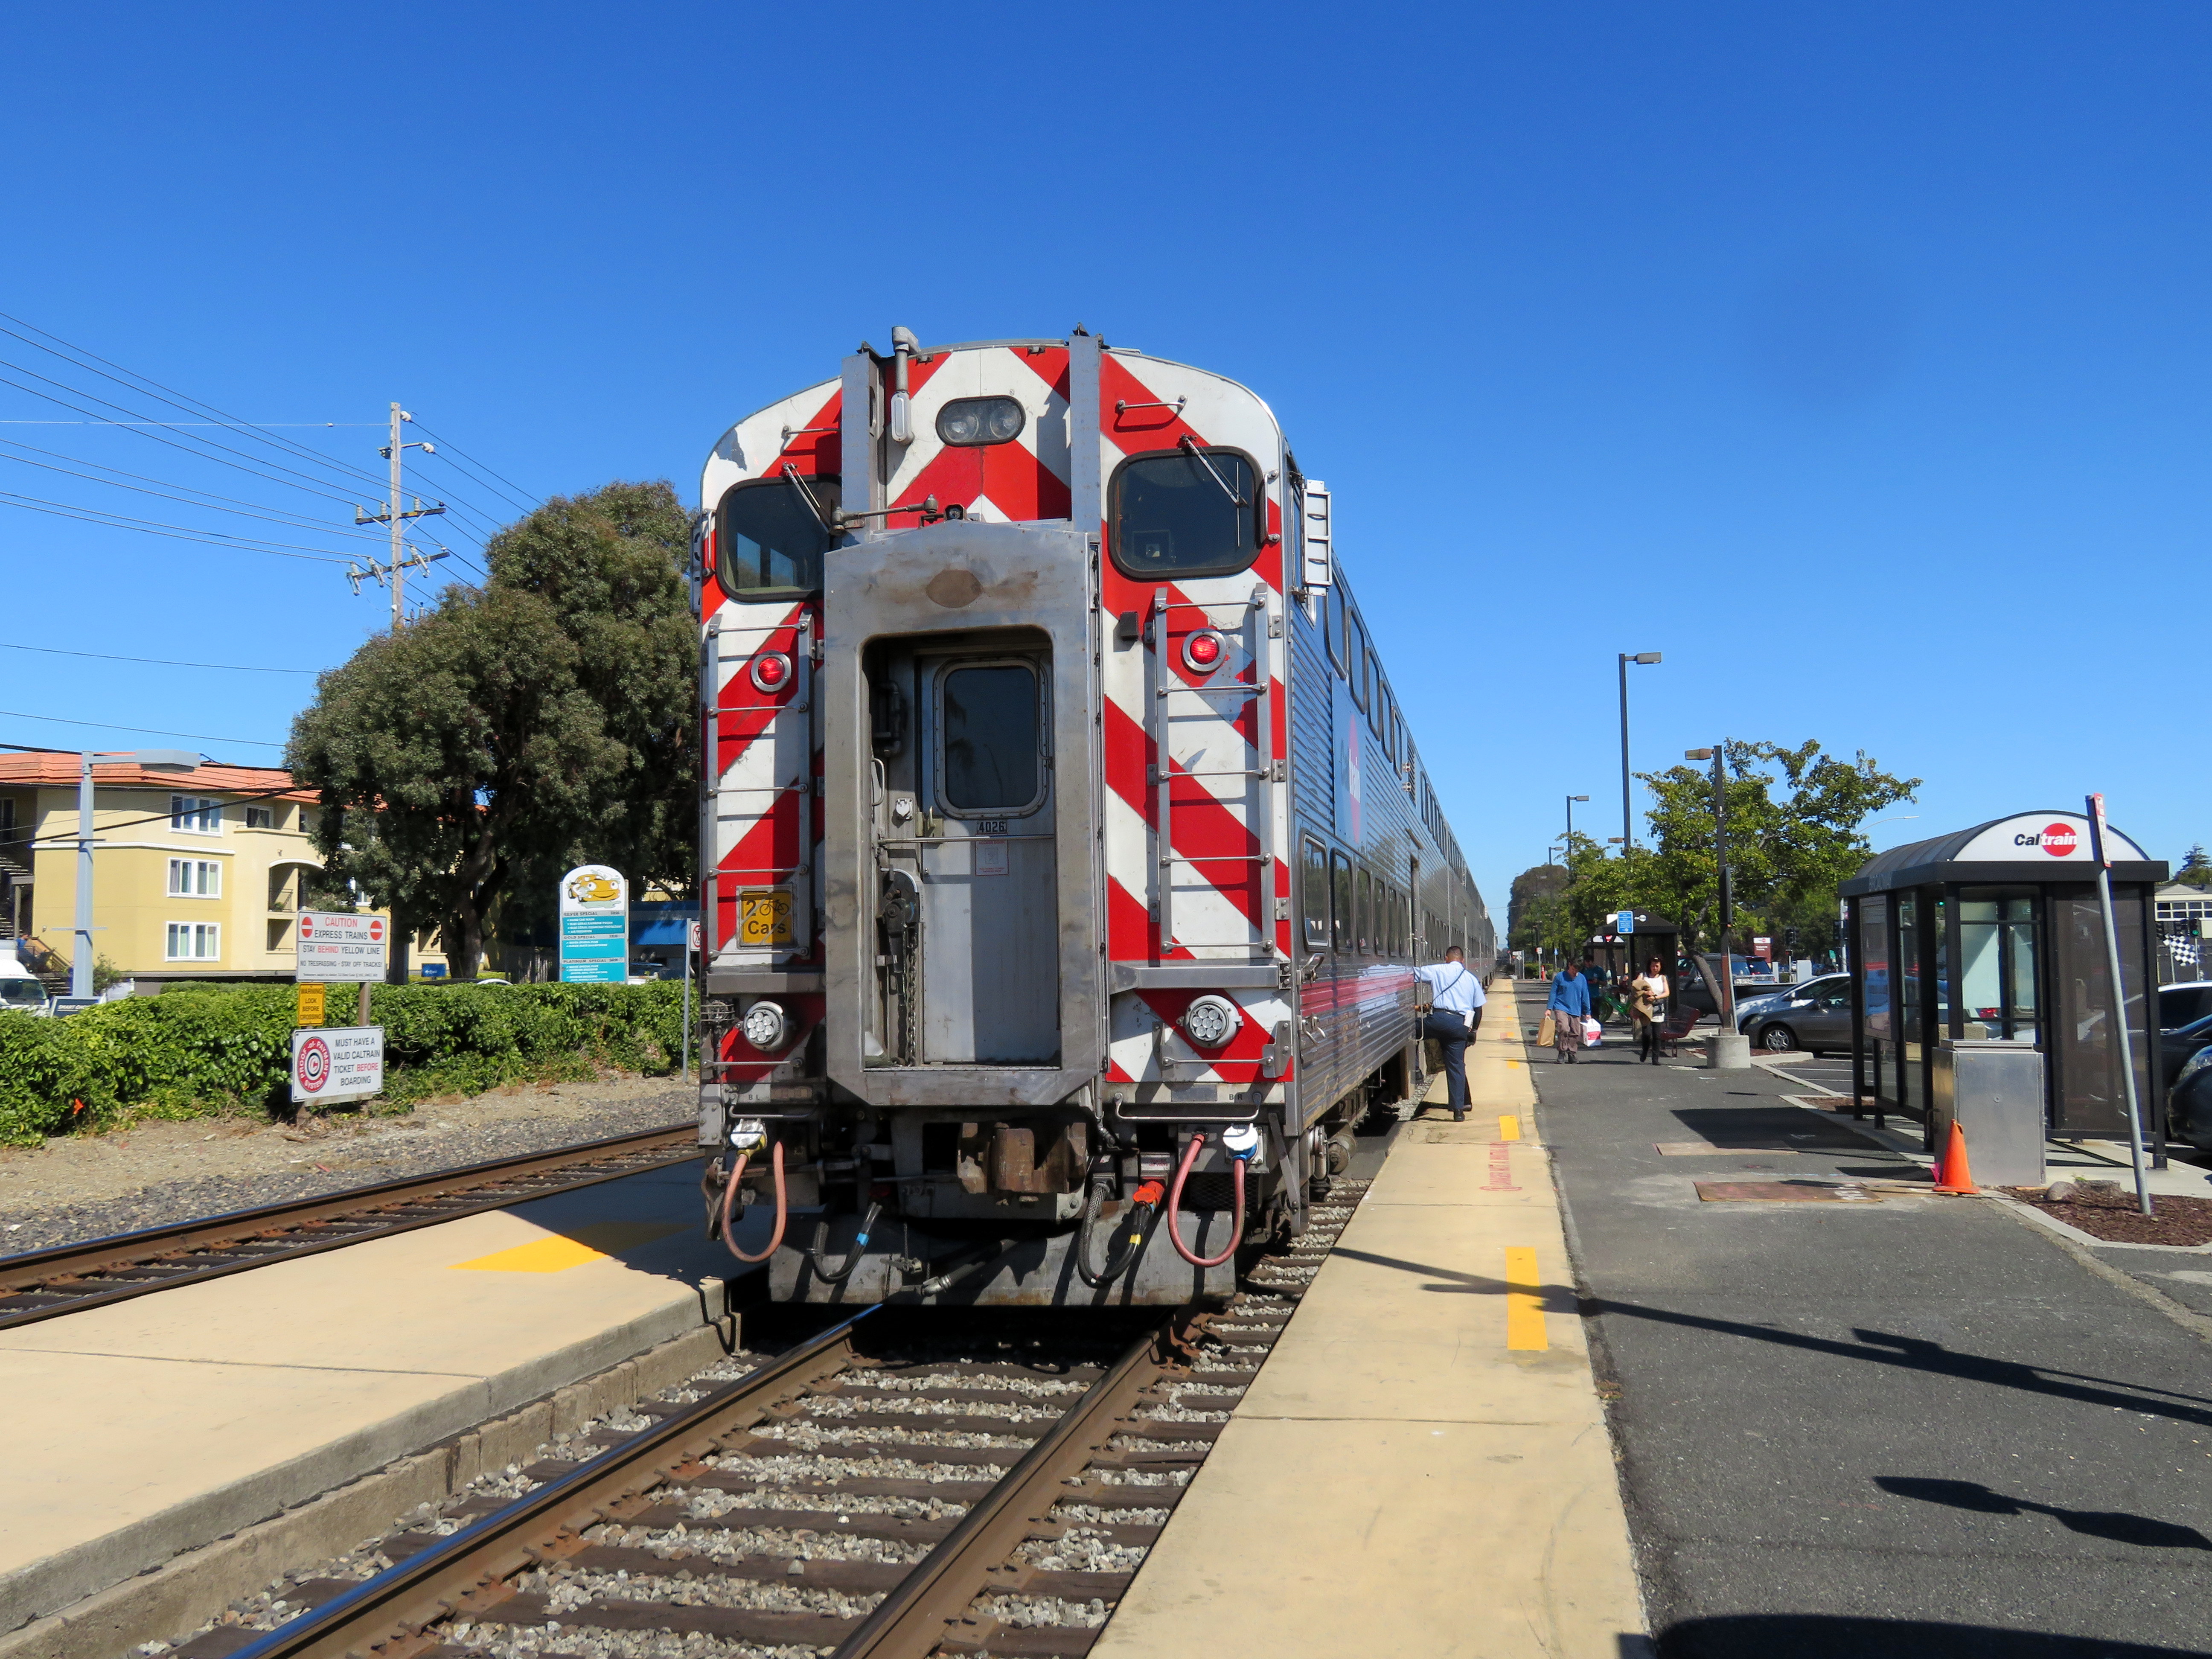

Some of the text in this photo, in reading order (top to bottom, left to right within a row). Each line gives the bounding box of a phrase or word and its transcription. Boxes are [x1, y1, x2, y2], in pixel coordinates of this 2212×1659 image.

[979, 821, 1005, 832] 4026
[2014, 832, 2078, 846] Caltrain
[746, 899, 757, 916] 2
[325, 917, 358, 927] CAUTION
[748, 920, 786, 935] Cars
[314, 930, 368, 940] EXPRESS TRAINS
[335, 1039, 352, 1047] MUST
[354, 1038, 370, 1046] HAVE
[317, 1041, 329, 1078] PAYMENT
[333, 1049, 380, 1060] VALID CALTRAIN
[334, 1062, 378, 1074] TICKET BEFORE
[304, 1078, 323, 1089] SYSTEM
[340, 1076, 371, 1086] BOARDING
